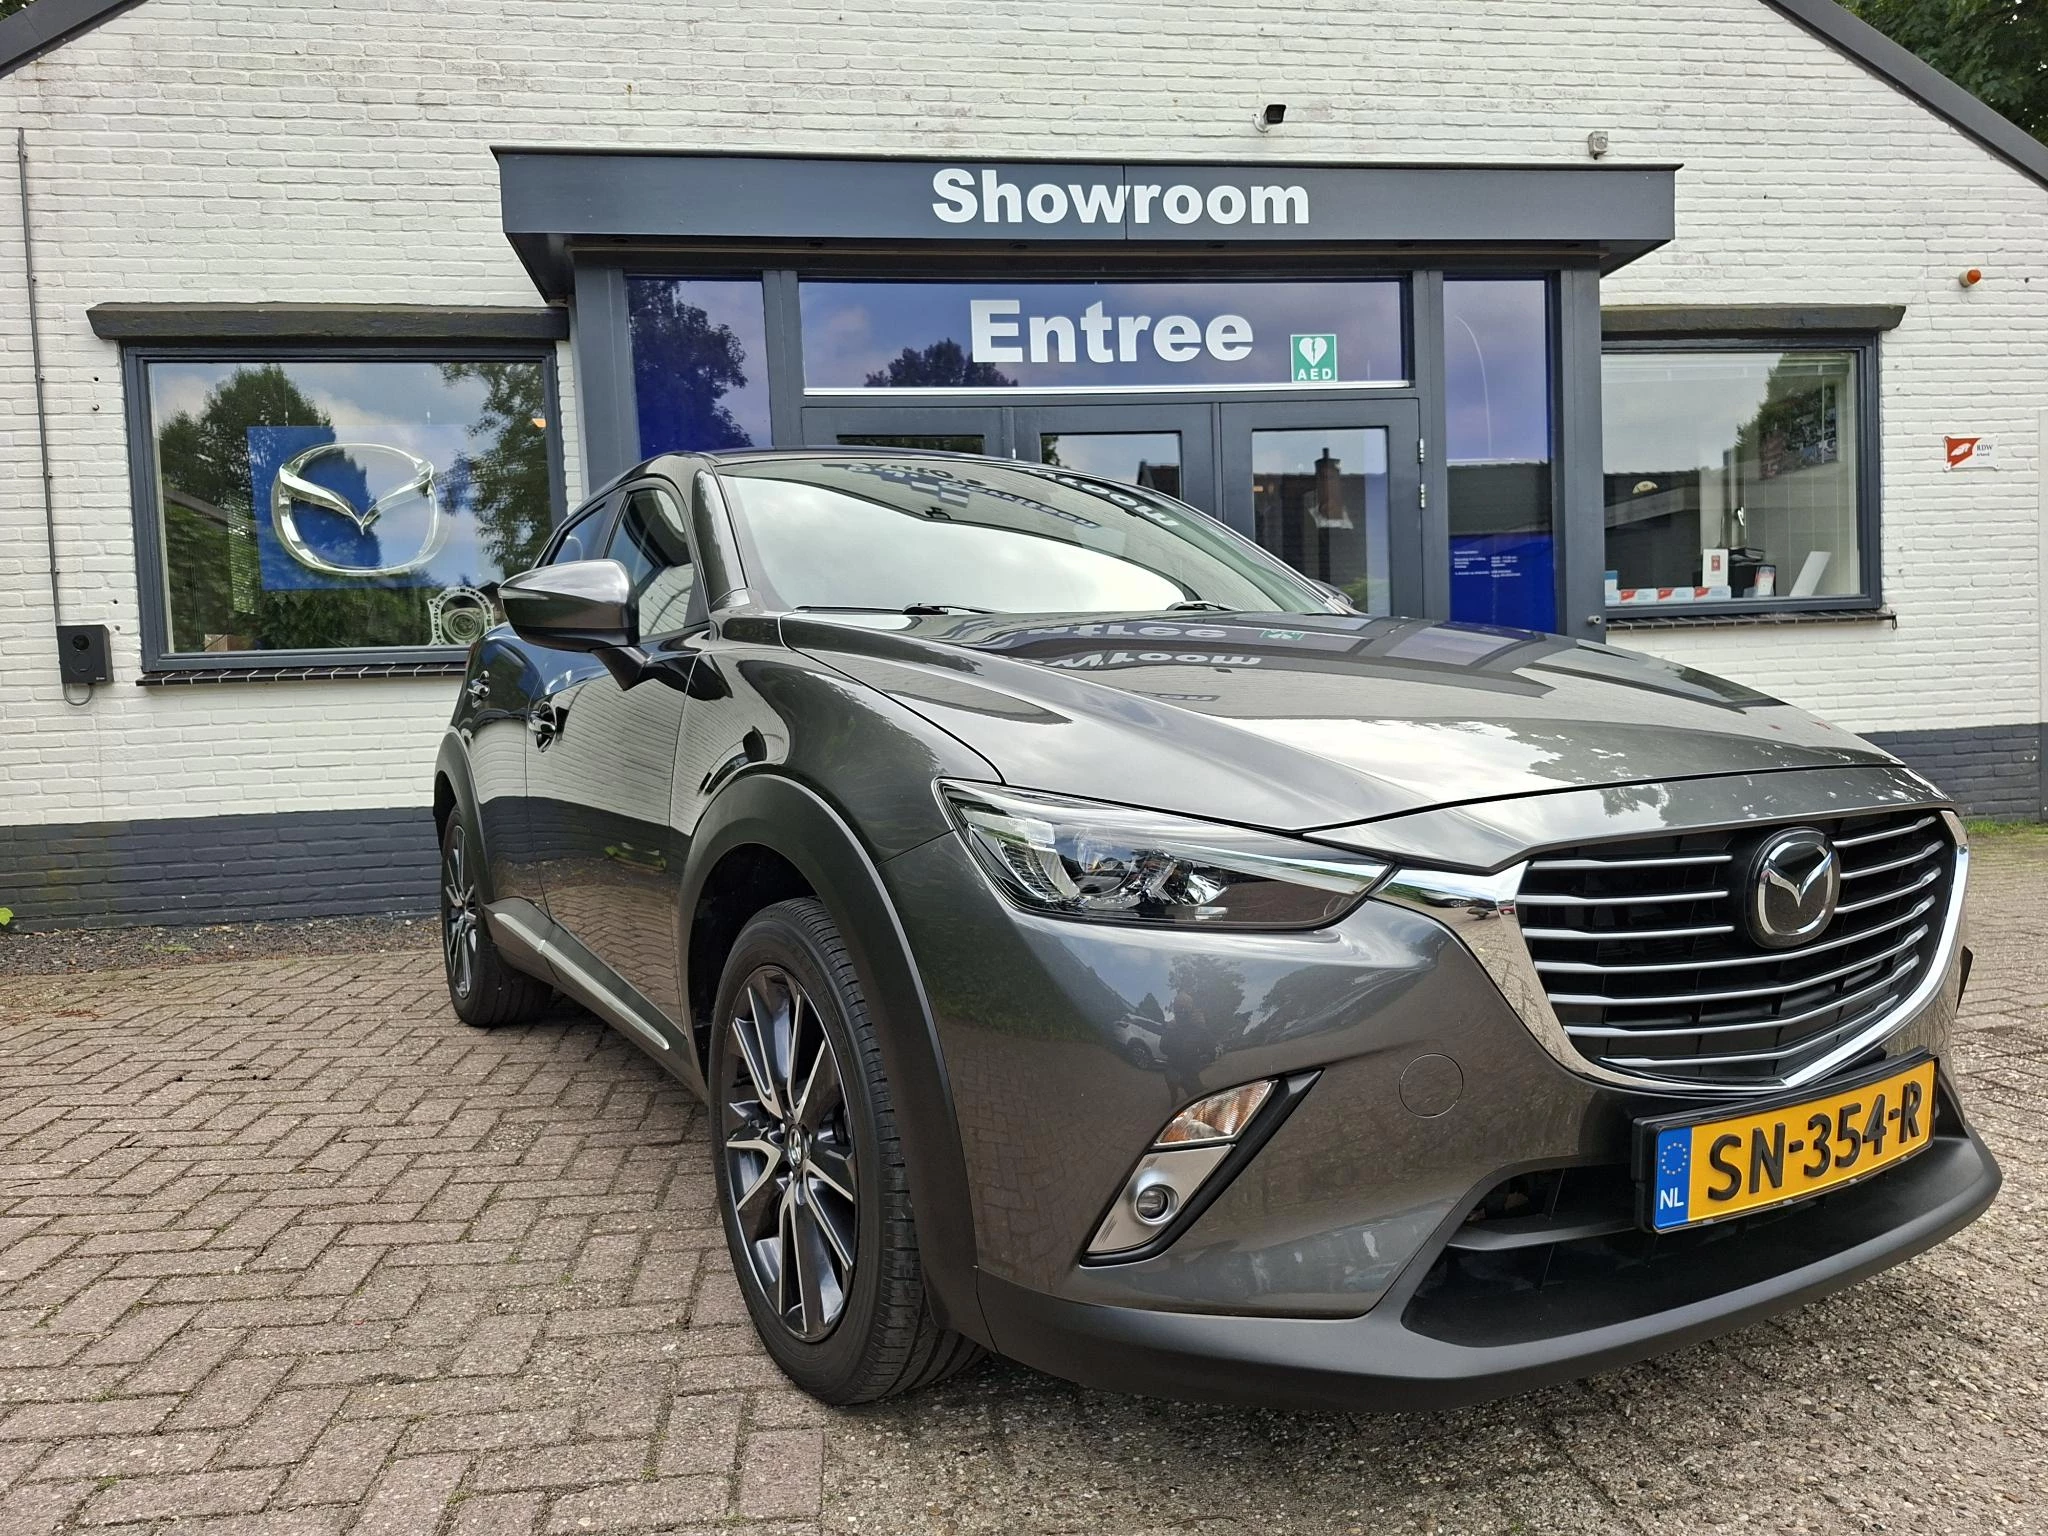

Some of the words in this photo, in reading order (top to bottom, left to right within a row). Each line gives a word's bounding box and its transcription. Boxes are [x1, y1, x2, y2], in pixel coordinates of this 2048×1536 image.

[932, 168, 1310, 224] Showroom
[970, 299, 1254, 364] Entree
[1297, 368, 1332, 380] AED
[1707, 1081, 1922, 1201] SN-354-R
[1660, 1187, 1684, 1209] NL
